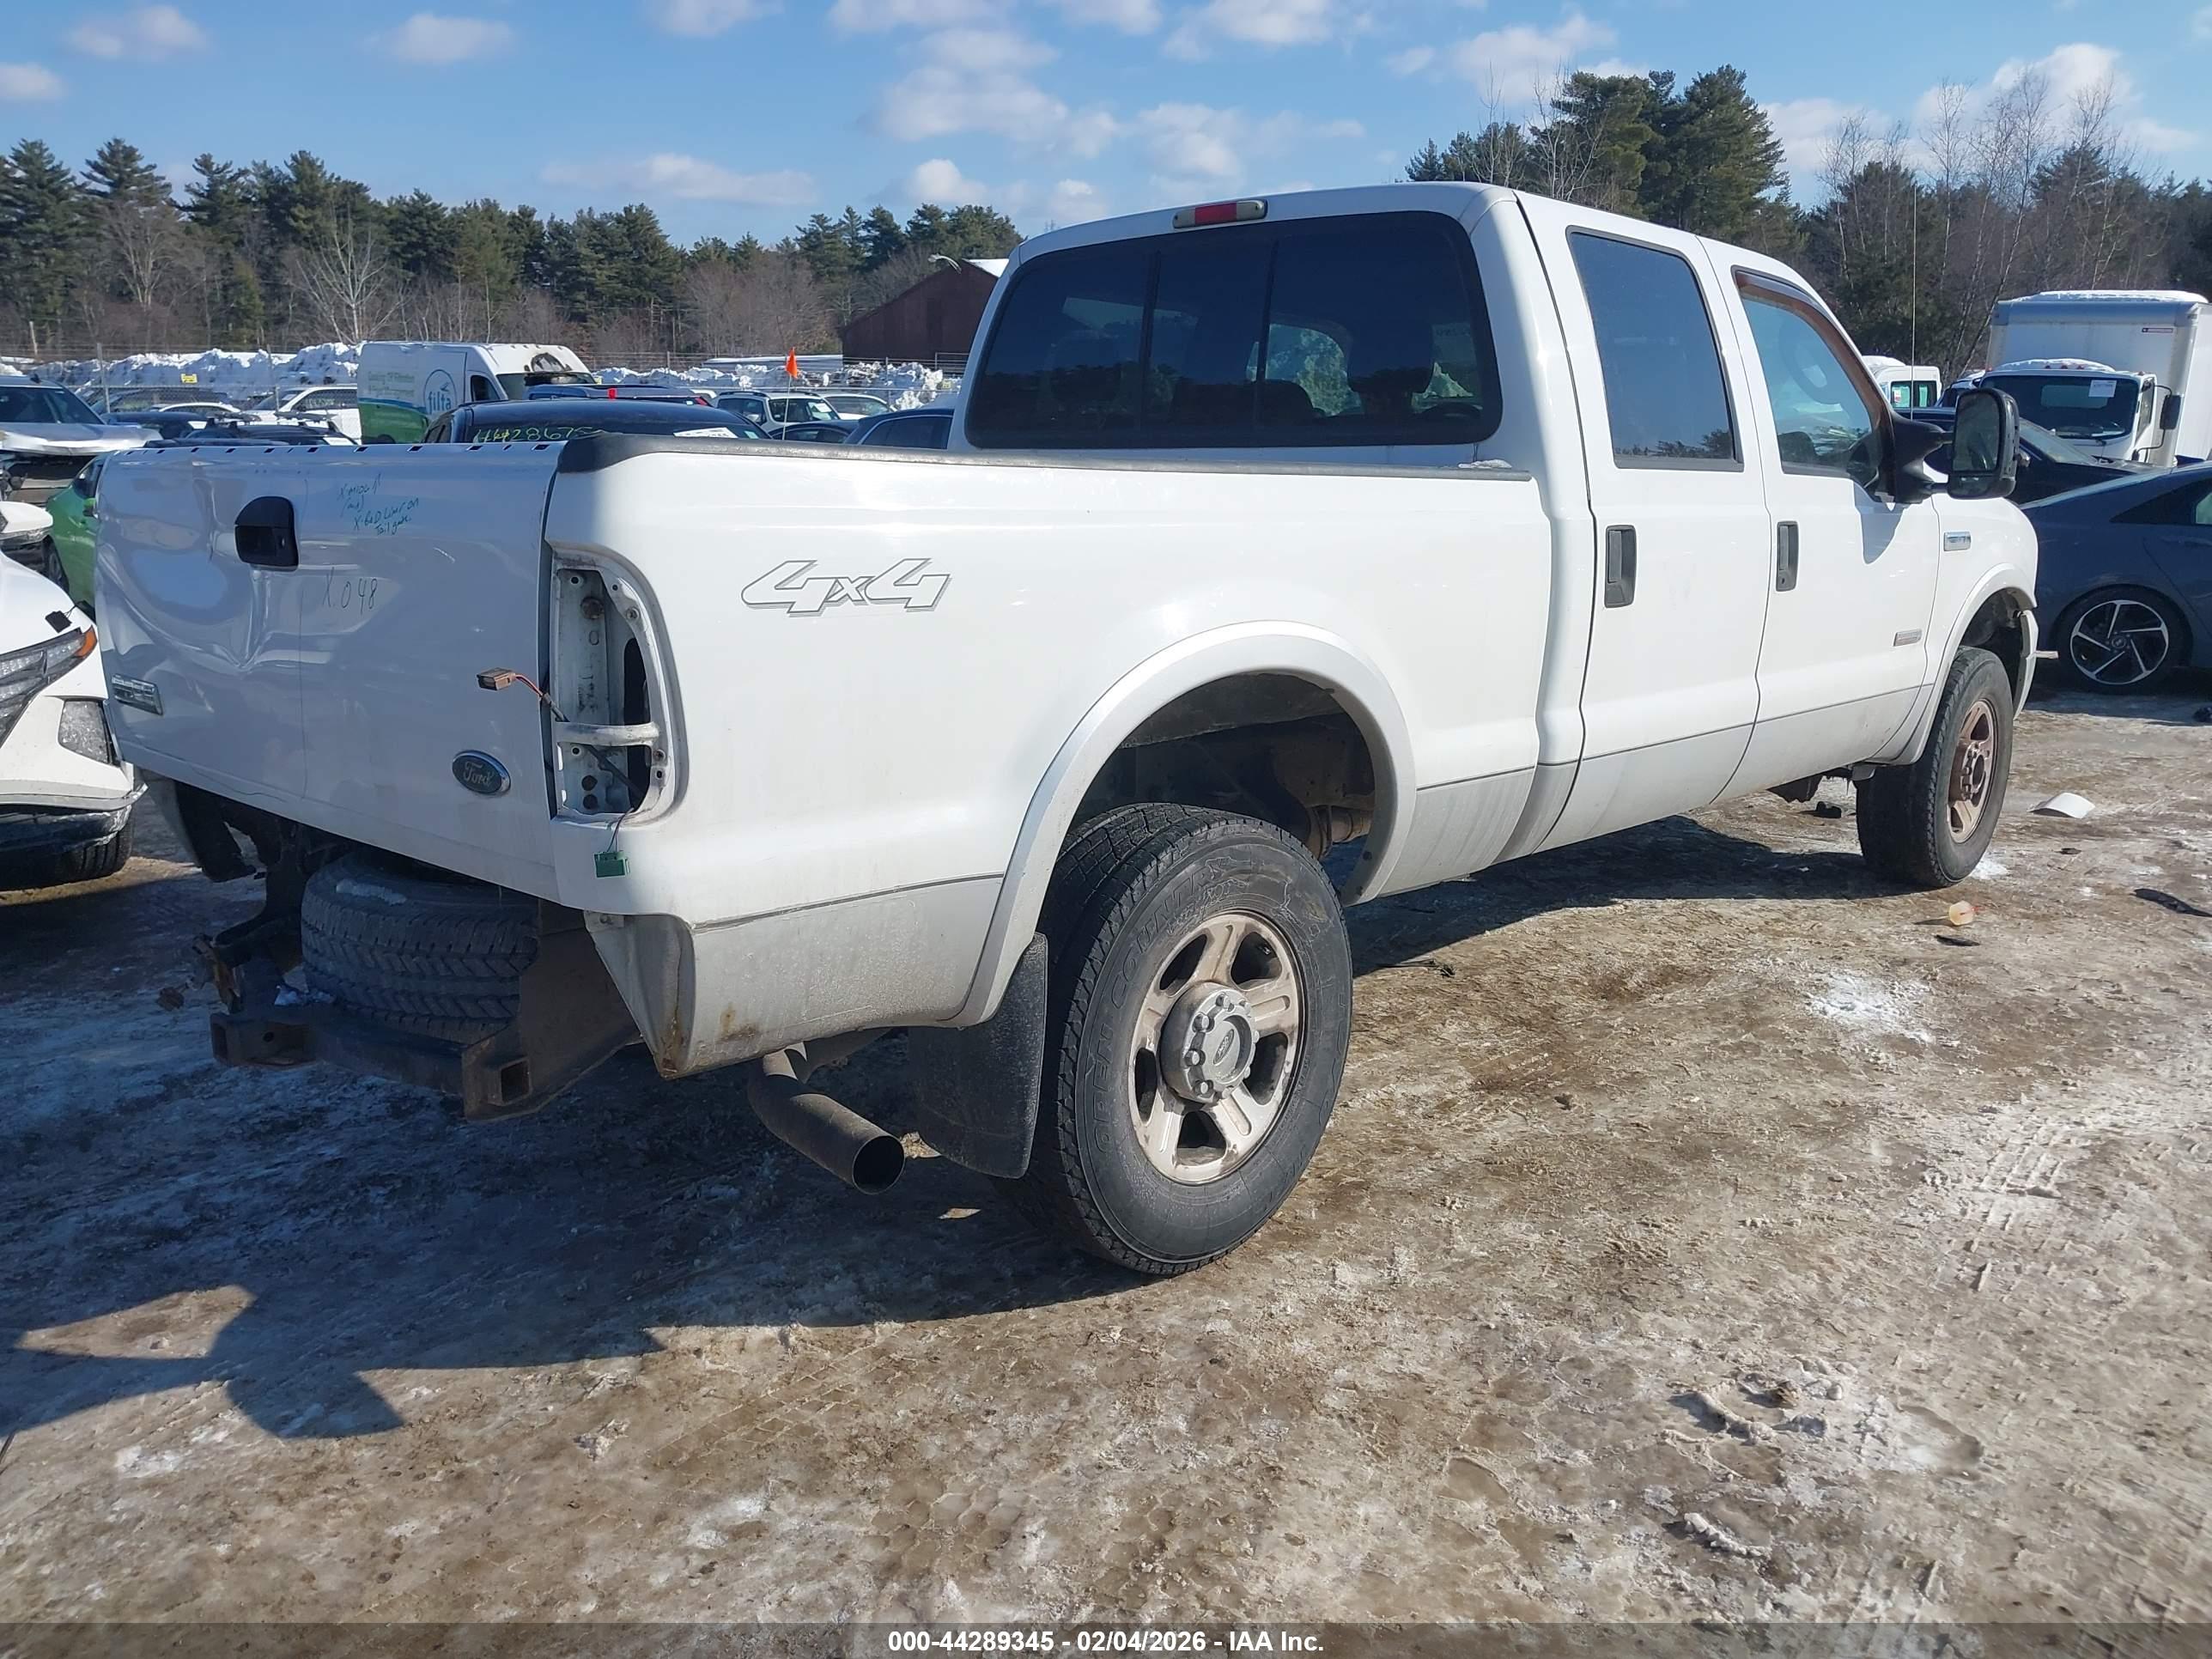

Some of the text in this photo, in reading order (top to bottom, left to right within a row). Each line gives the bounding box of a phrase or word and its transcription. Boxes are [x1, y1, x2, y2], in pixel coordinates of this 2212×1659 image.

[428, 391, 452, 415] filta
[740, 556, 953, 617] 4x4
[463, 761, 495, 787] Ford
